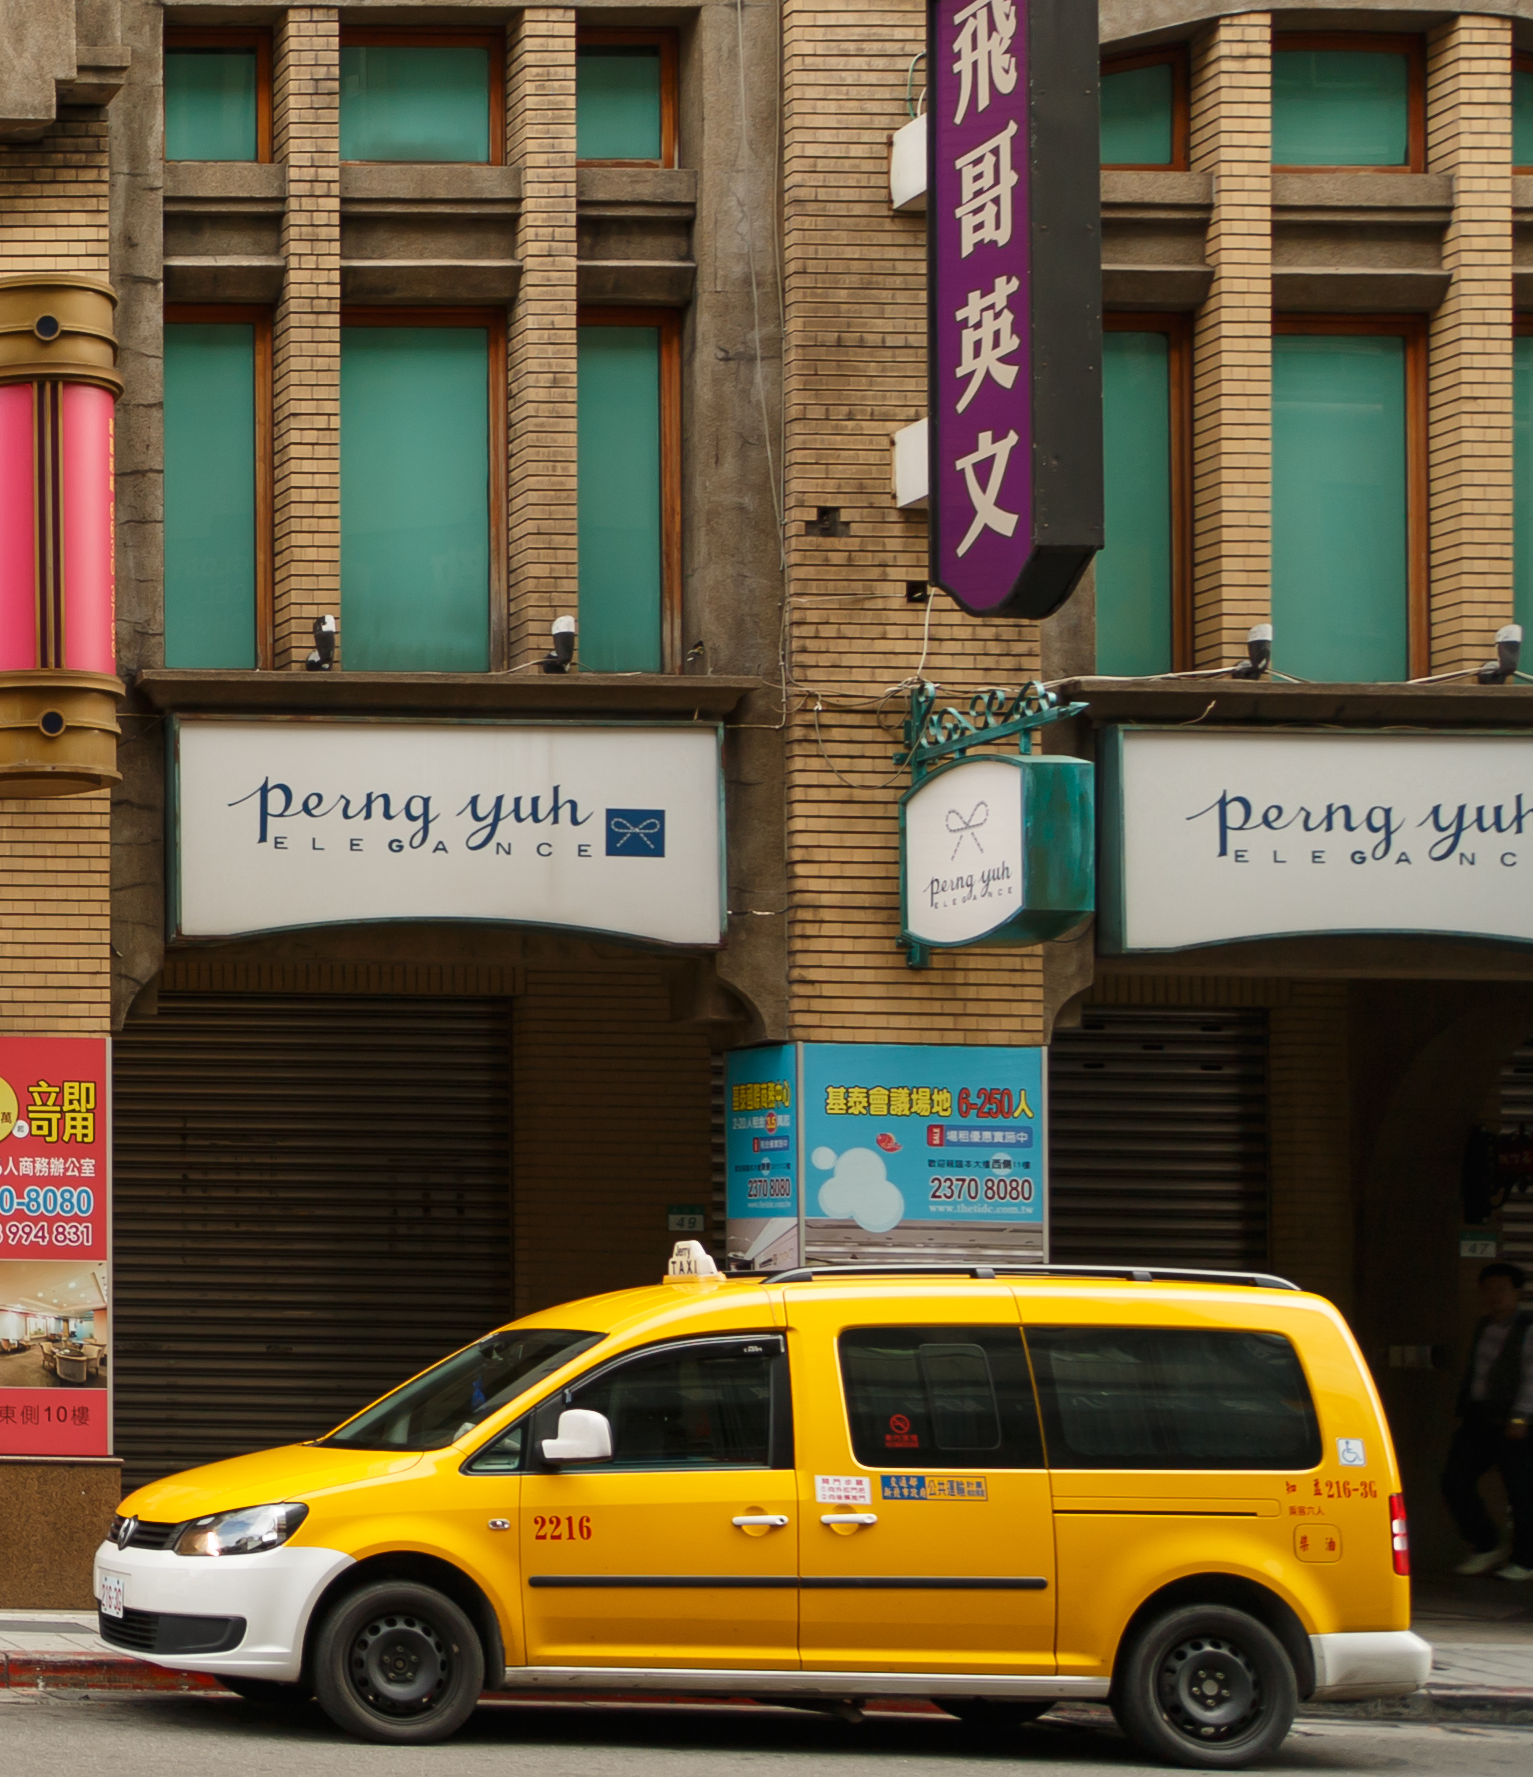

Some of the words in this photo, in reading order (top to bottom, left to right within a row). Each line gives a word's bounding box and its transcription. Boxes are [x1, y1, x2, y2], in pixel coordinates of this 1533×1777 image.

[273, 835, 595, 858] ELEGANCE
[825, 1085, 953, 1117] 基泰會議場地
[957, 1087, 1035, 1119] 6-250人
[929, 1176, 979, 1202] 2370
[984, 1177, 1033, 1203] 8080
[5, 1221, 49, 1246] 994
[51, 1222, 93, 1246] 831
[675, 1216, 697, 1229] 49
[670, 1260, 698, 1274] TAXI
[1325, 1479, 1378, 1499] 216-3G
[533, 1514, 593, 1542] 2216
